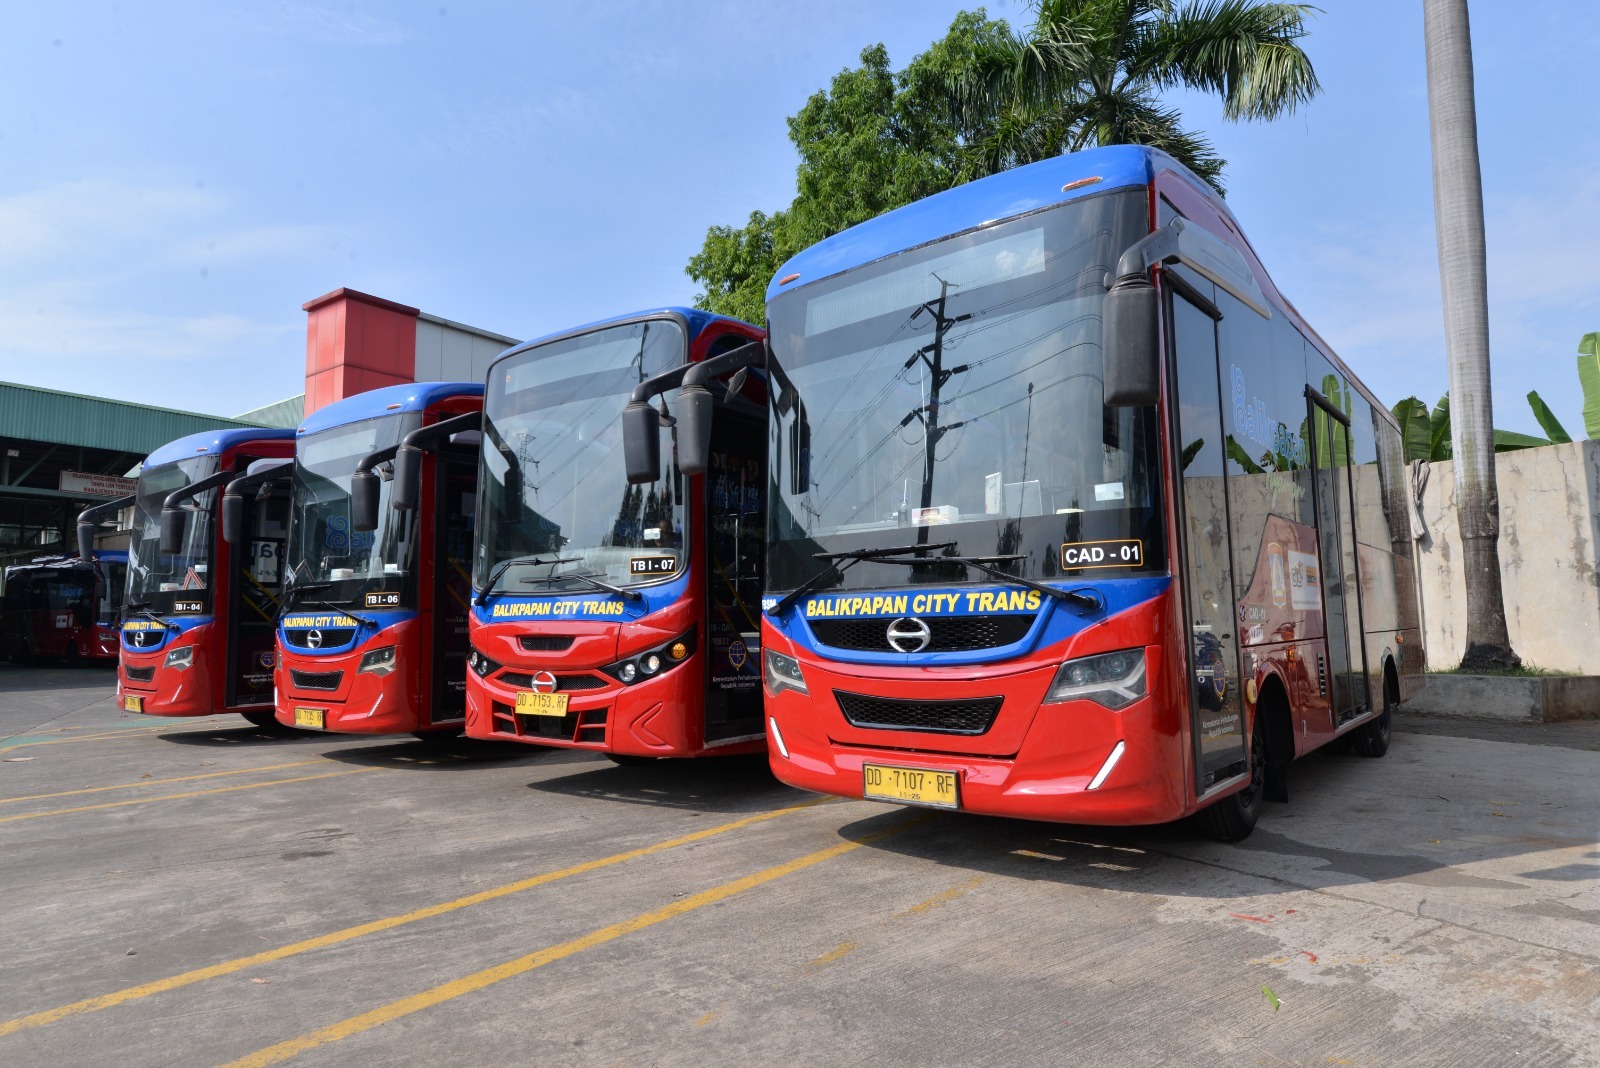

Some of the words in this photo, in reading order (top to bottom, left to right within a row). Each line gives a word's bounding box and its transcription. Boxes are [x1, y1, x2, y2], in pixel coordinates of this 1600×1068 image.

[1066, 547, 1104, 563] CAD
[1120, 545, 1138, 560] 01
[661, 560, 674, 570] 07
[493, 602, 552, 617] BALIKPAPAN
[553, 601, 581, 615] CITY
[582, 601, 624, 615] TRANS
[807, 595, 908, 617] BALIKPAPAN
[912, 593, 961, 613] CITY
[966, 589, 1041, 611] TRANS
[284, 617, 314, 627] BALIKPAPAN
[316, 617, 330, 626] CITY
[517, 694, 527, 706] DD
[557, 696, 566, 708] RF
[867, 768, 881, 785] DD
[937, 775, 952, 793] RF
